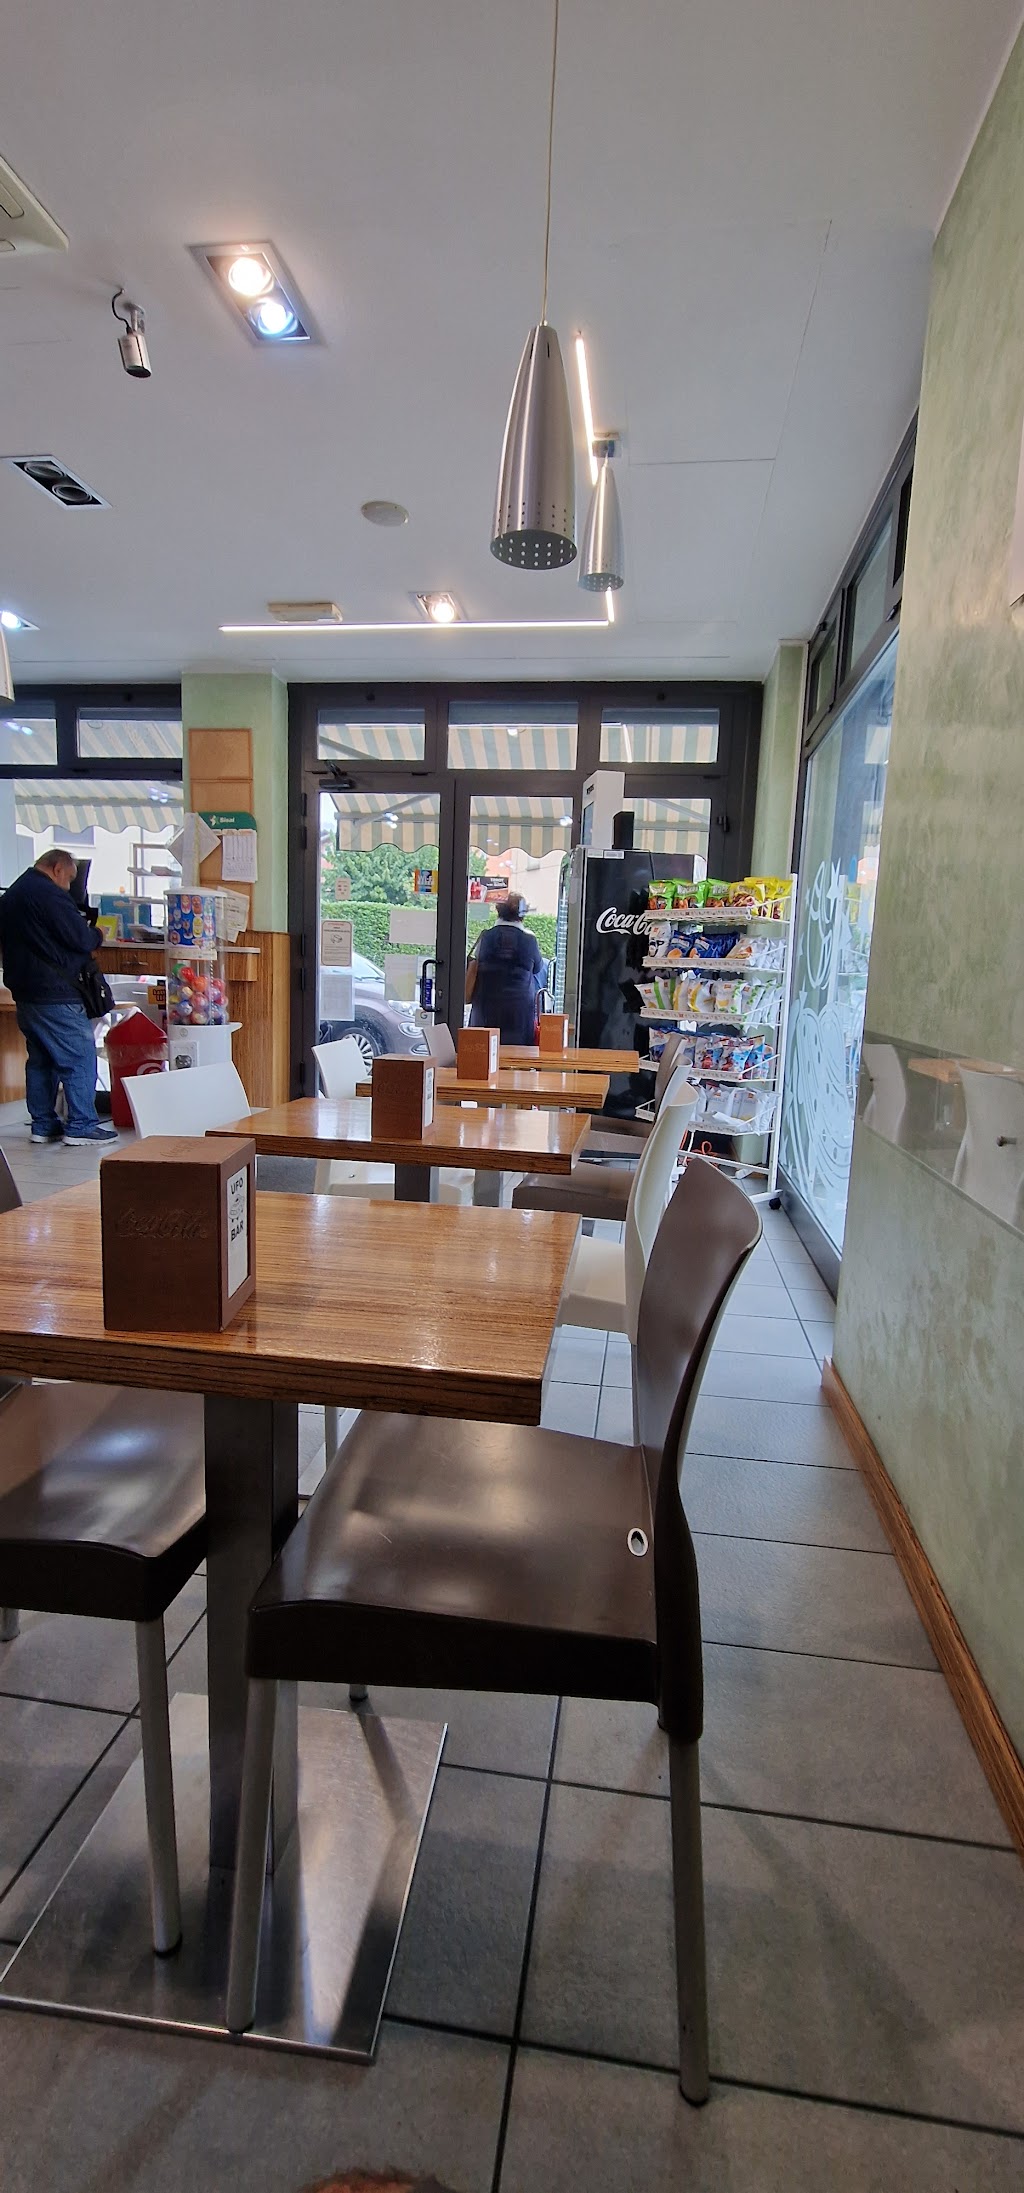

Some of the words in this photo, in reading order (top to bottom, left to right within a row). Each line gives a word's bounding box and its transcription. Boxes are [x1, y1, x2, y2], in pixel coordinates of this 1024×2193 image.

[596, 907, 651, 935] Coca-Co
[230, 1177, 244, 1195] UFO
[230, 1220, 244, 1241] BAR
